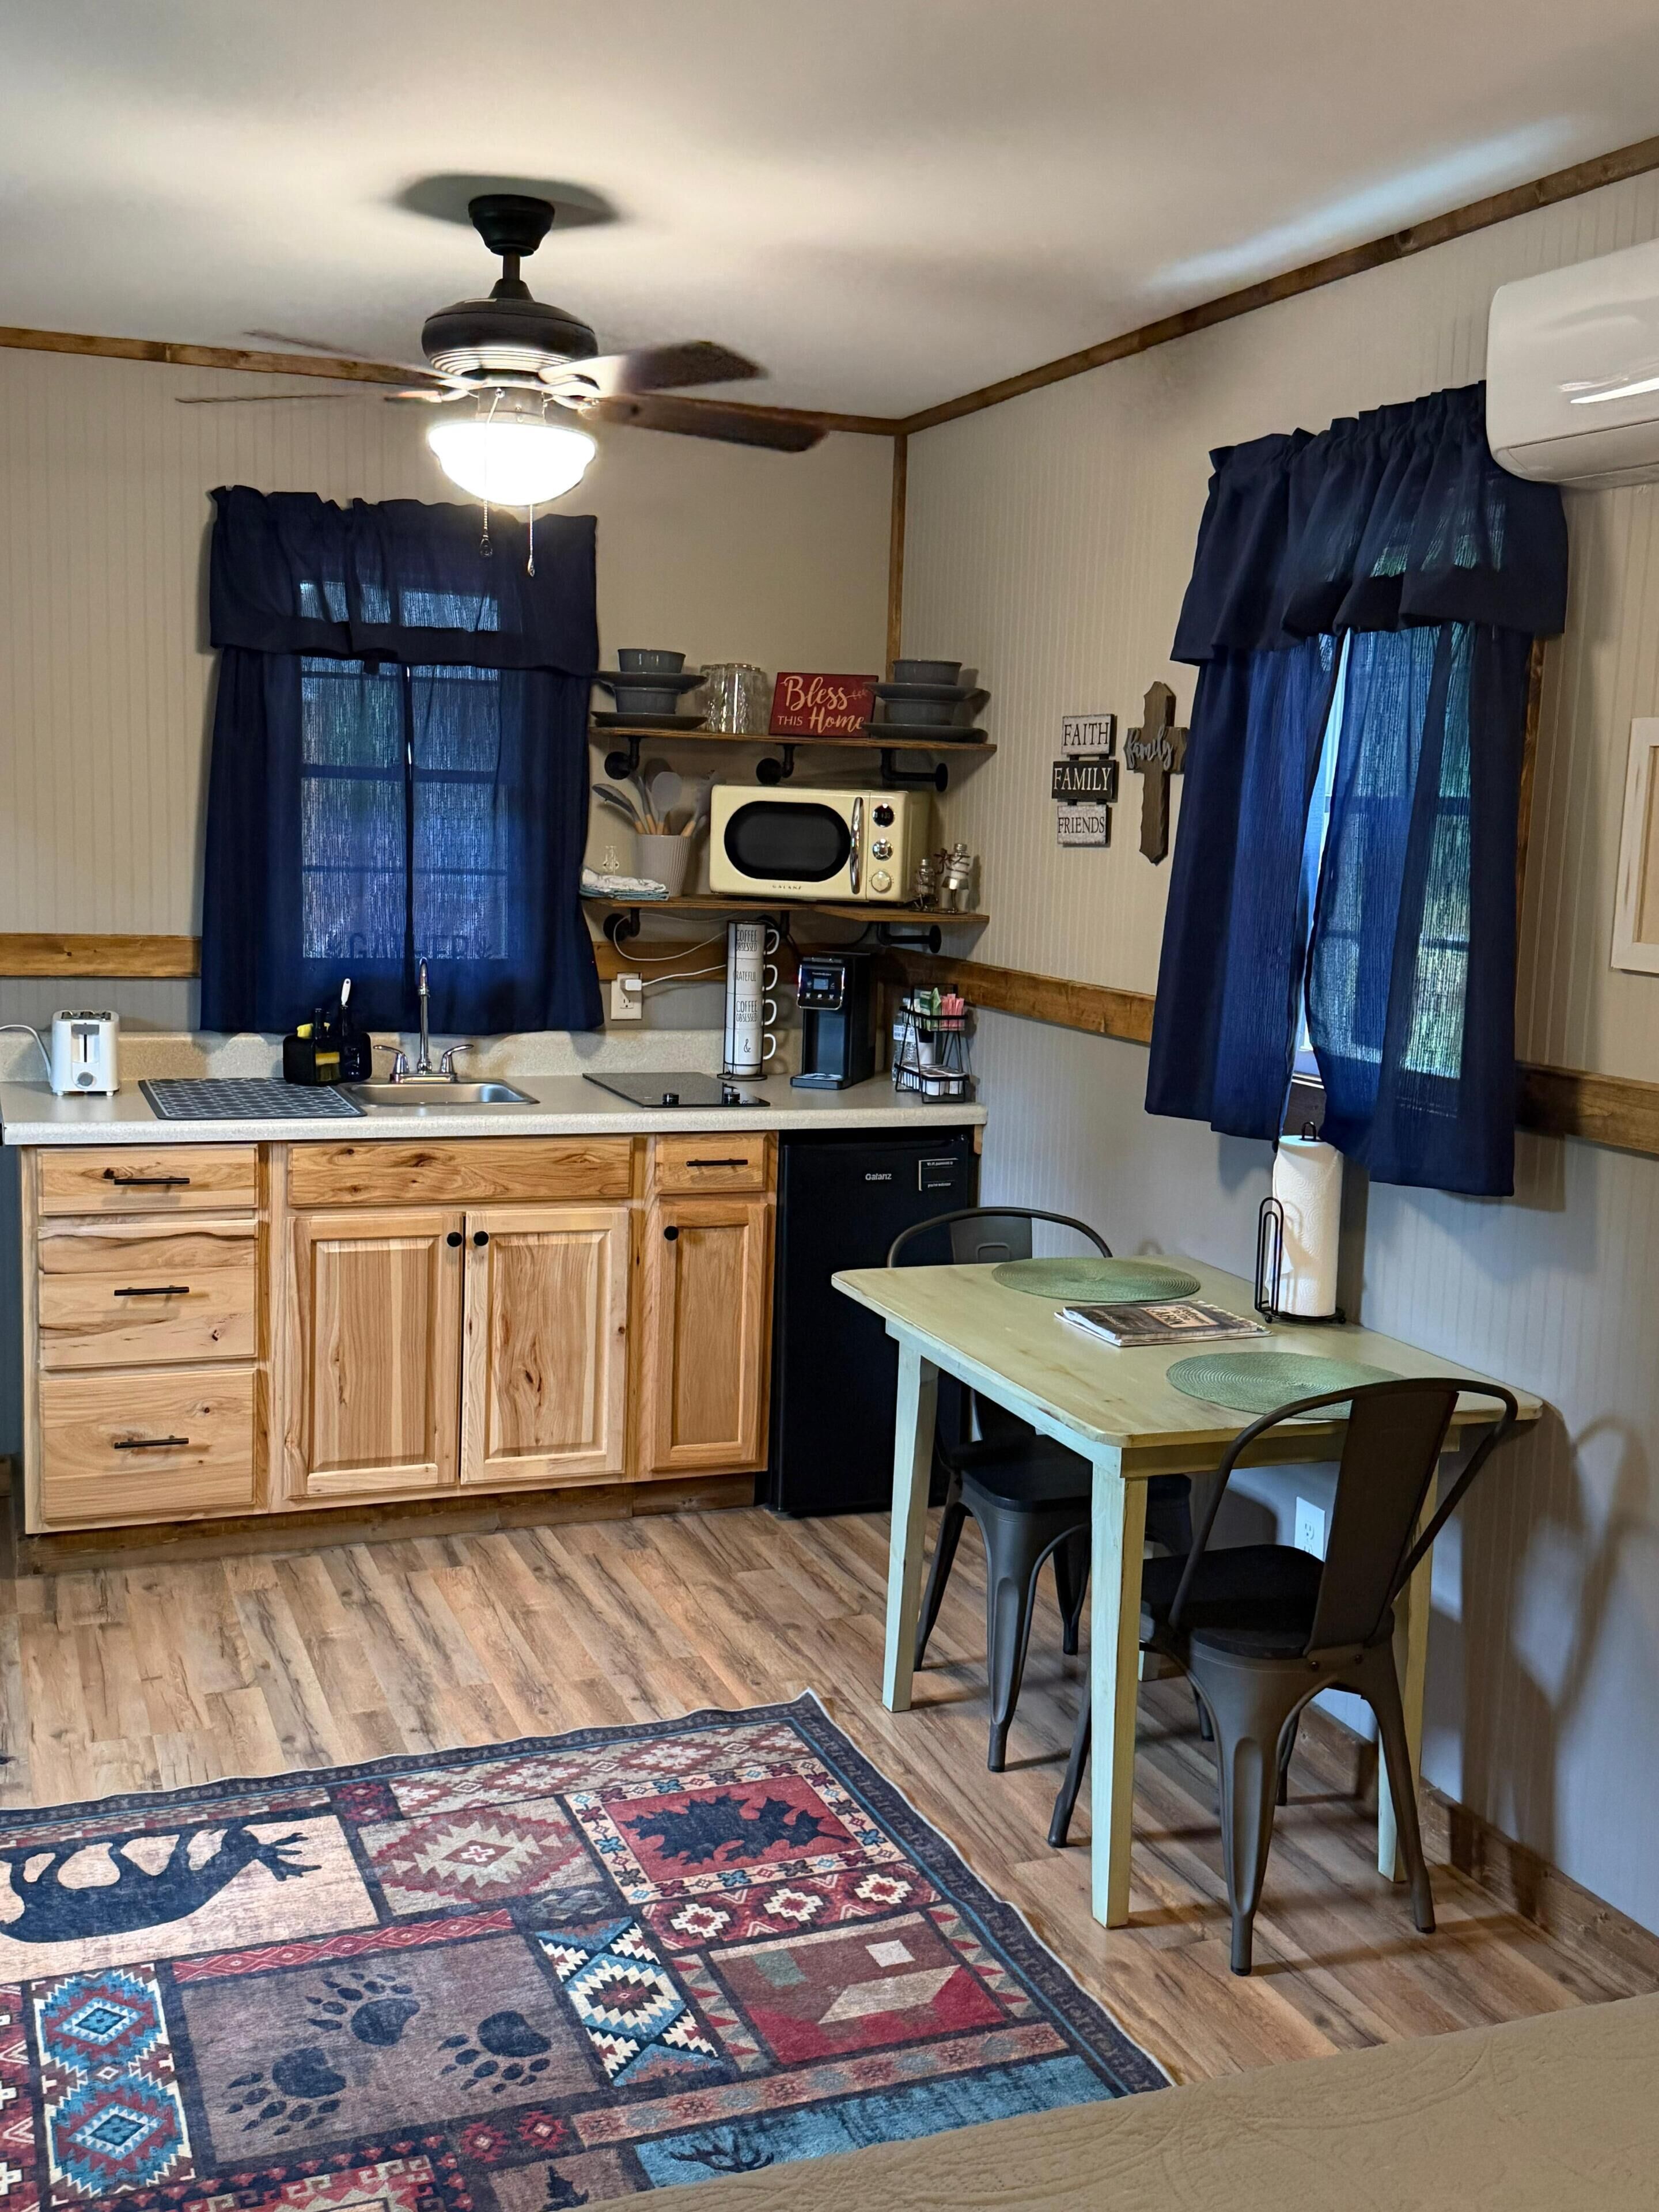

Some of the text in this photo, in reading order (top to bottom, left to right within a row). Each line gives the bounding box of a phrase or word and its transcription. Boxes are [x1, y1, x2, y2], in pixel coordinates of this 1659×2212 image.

[781, 676, 849, 711] Bless
[778, 706, 865, 733] THIS Home
[1063, 722, 1109, 746] FAITH
[1127, 725, 1173, 771] family
[1054, 767, 1112, 791] FAMILY
[1058, 816, 1105, 834] FRIENDS
[737, 929, 757, 942] COFFEE
[736, 1000, 757, 1013] COFFEE
[736, 1013, 758, 1022] OBSESSED
[744, 1038, 752, 1053] &
[865, 1173, 892, 1181] Galanz
